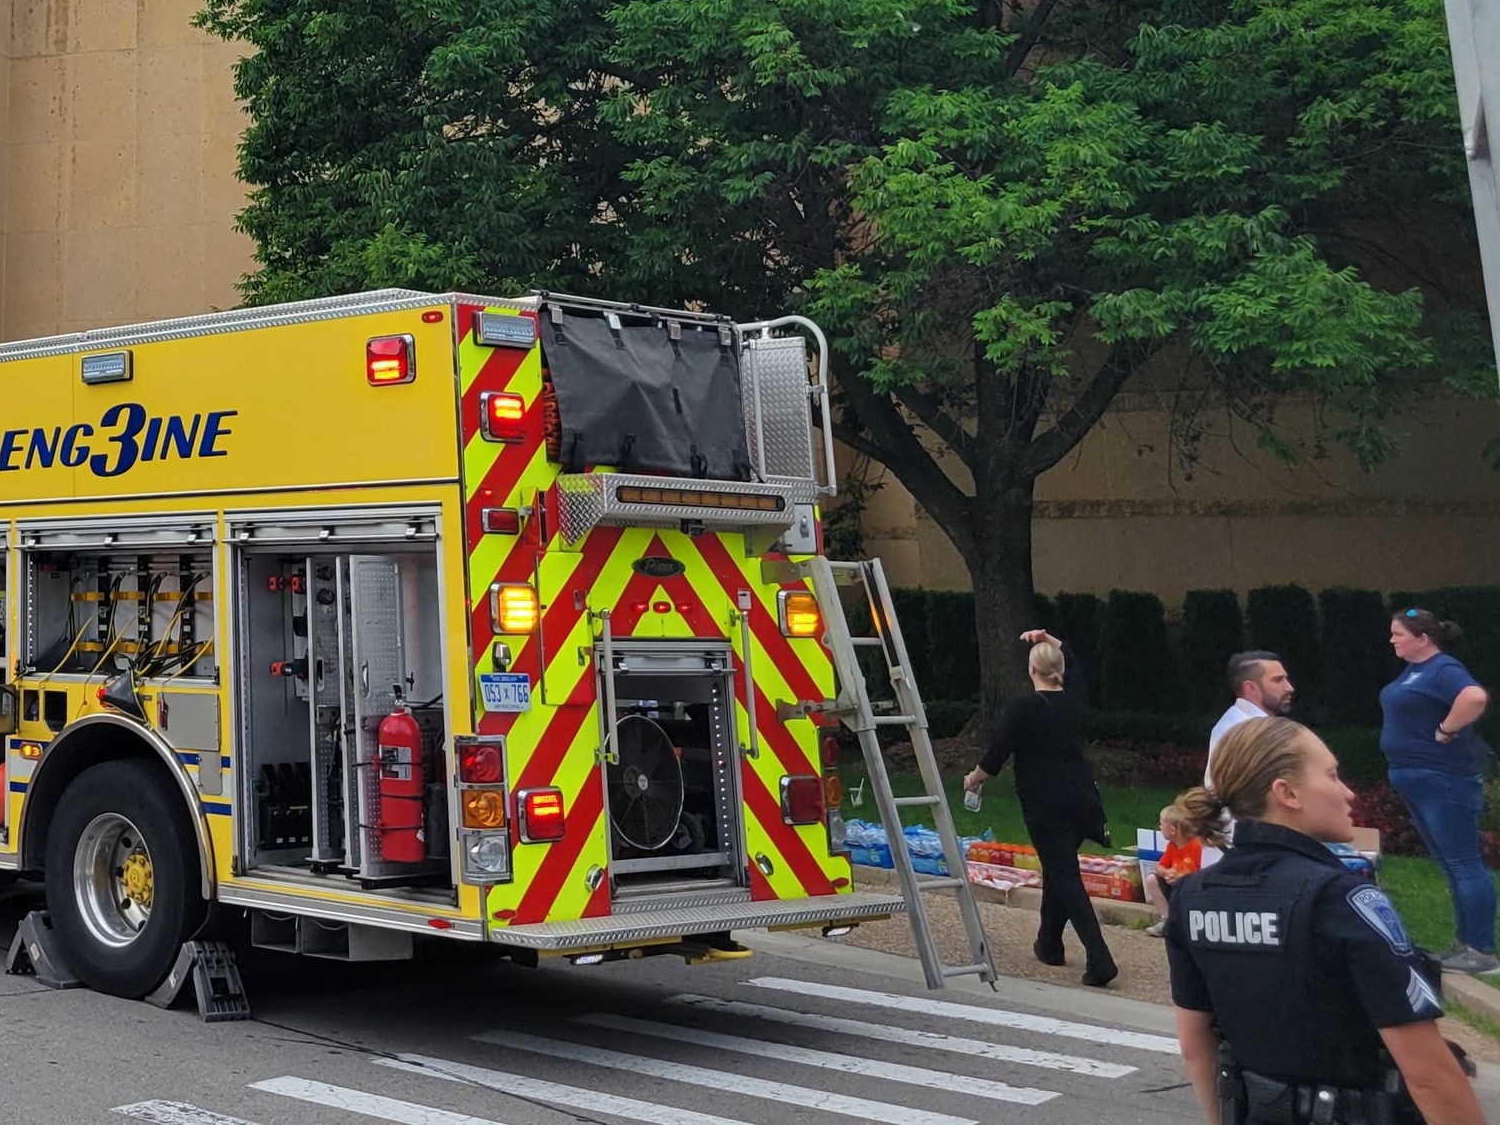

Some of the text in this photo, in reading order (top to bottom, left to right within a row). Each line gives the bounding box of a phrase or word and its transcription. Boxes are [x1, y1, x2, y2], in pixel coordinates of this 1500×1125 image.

[485, 684, 501, 702] 053
[512, 684, 529, 703] 766
[1189, 910, 1279, 945] POLICE
